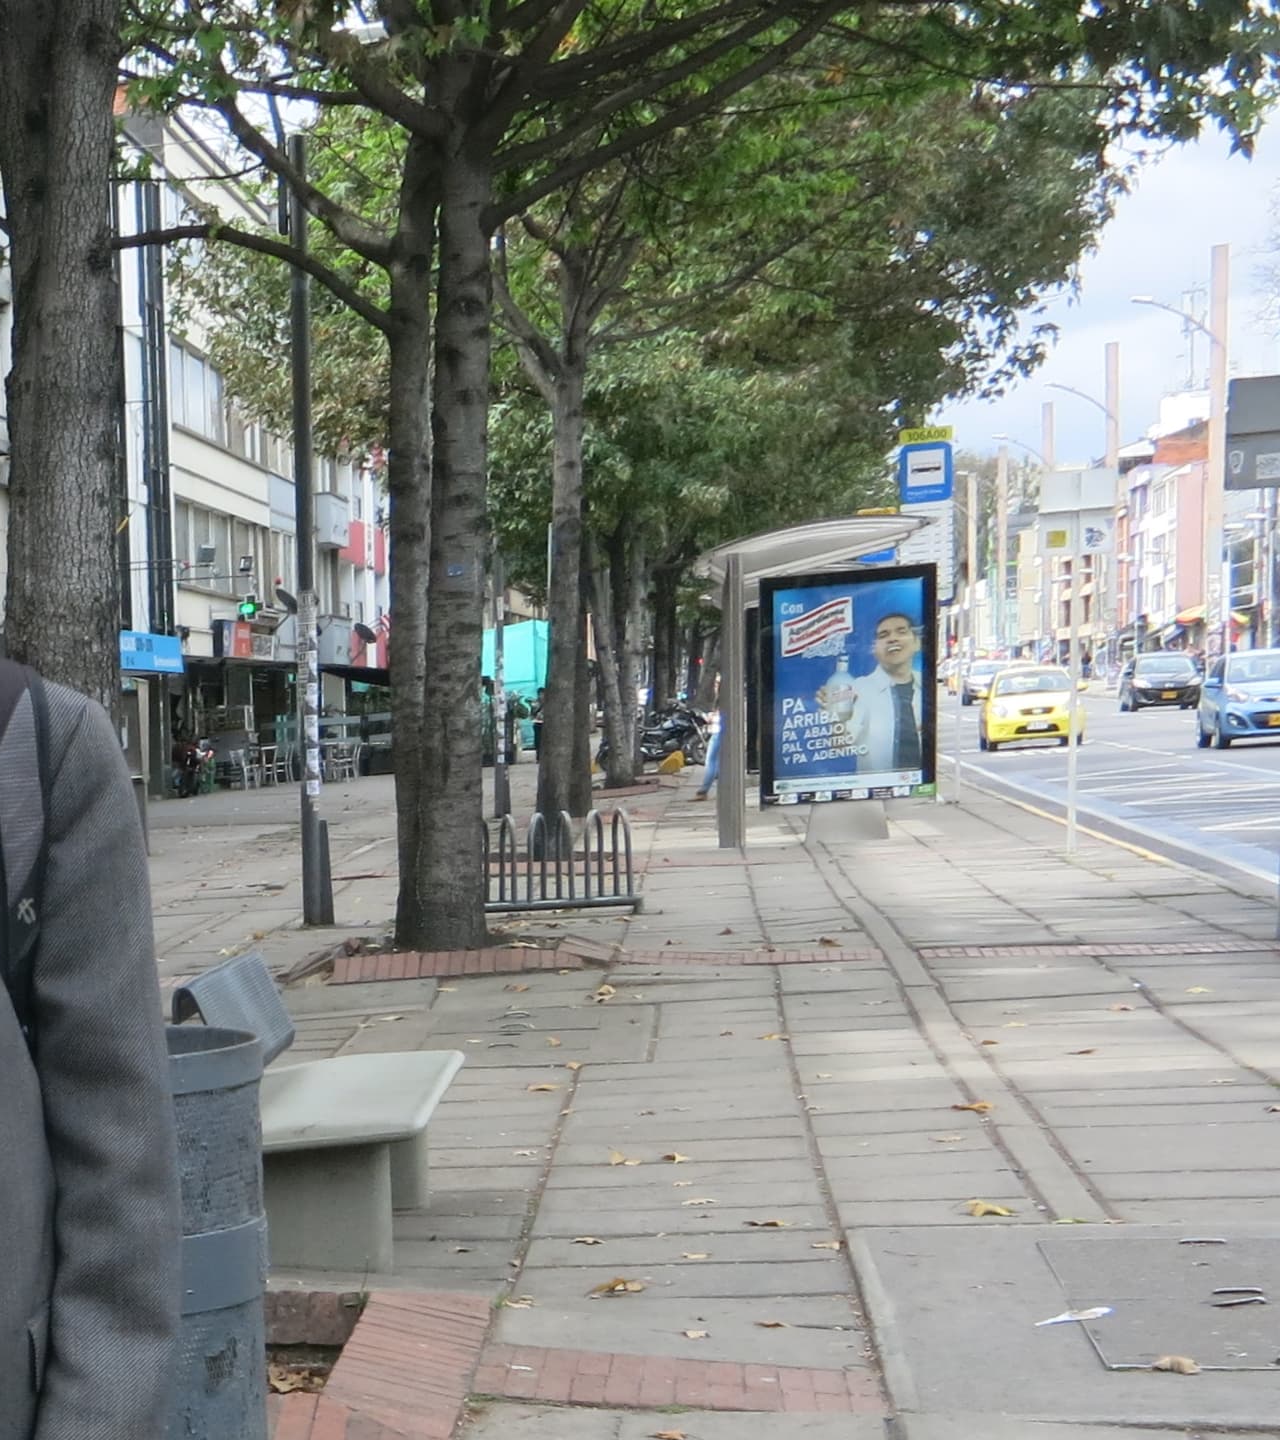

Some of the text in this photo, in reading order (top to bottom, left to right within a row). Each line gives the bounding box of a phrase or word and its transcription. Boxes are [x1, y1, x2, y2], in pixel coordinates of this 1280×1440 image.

[781, 602, 804, 615] Con
[782, 697, 806, 716] PA
[783, 711, 840, 730] ARRIBA
[782, 723, 844, 742] PA ABAJO
[782, 734, 856, 754] PAL CENTRO
[791, 753, 808, 764] PA
[812, 744, 868, 762] ADENTRO
